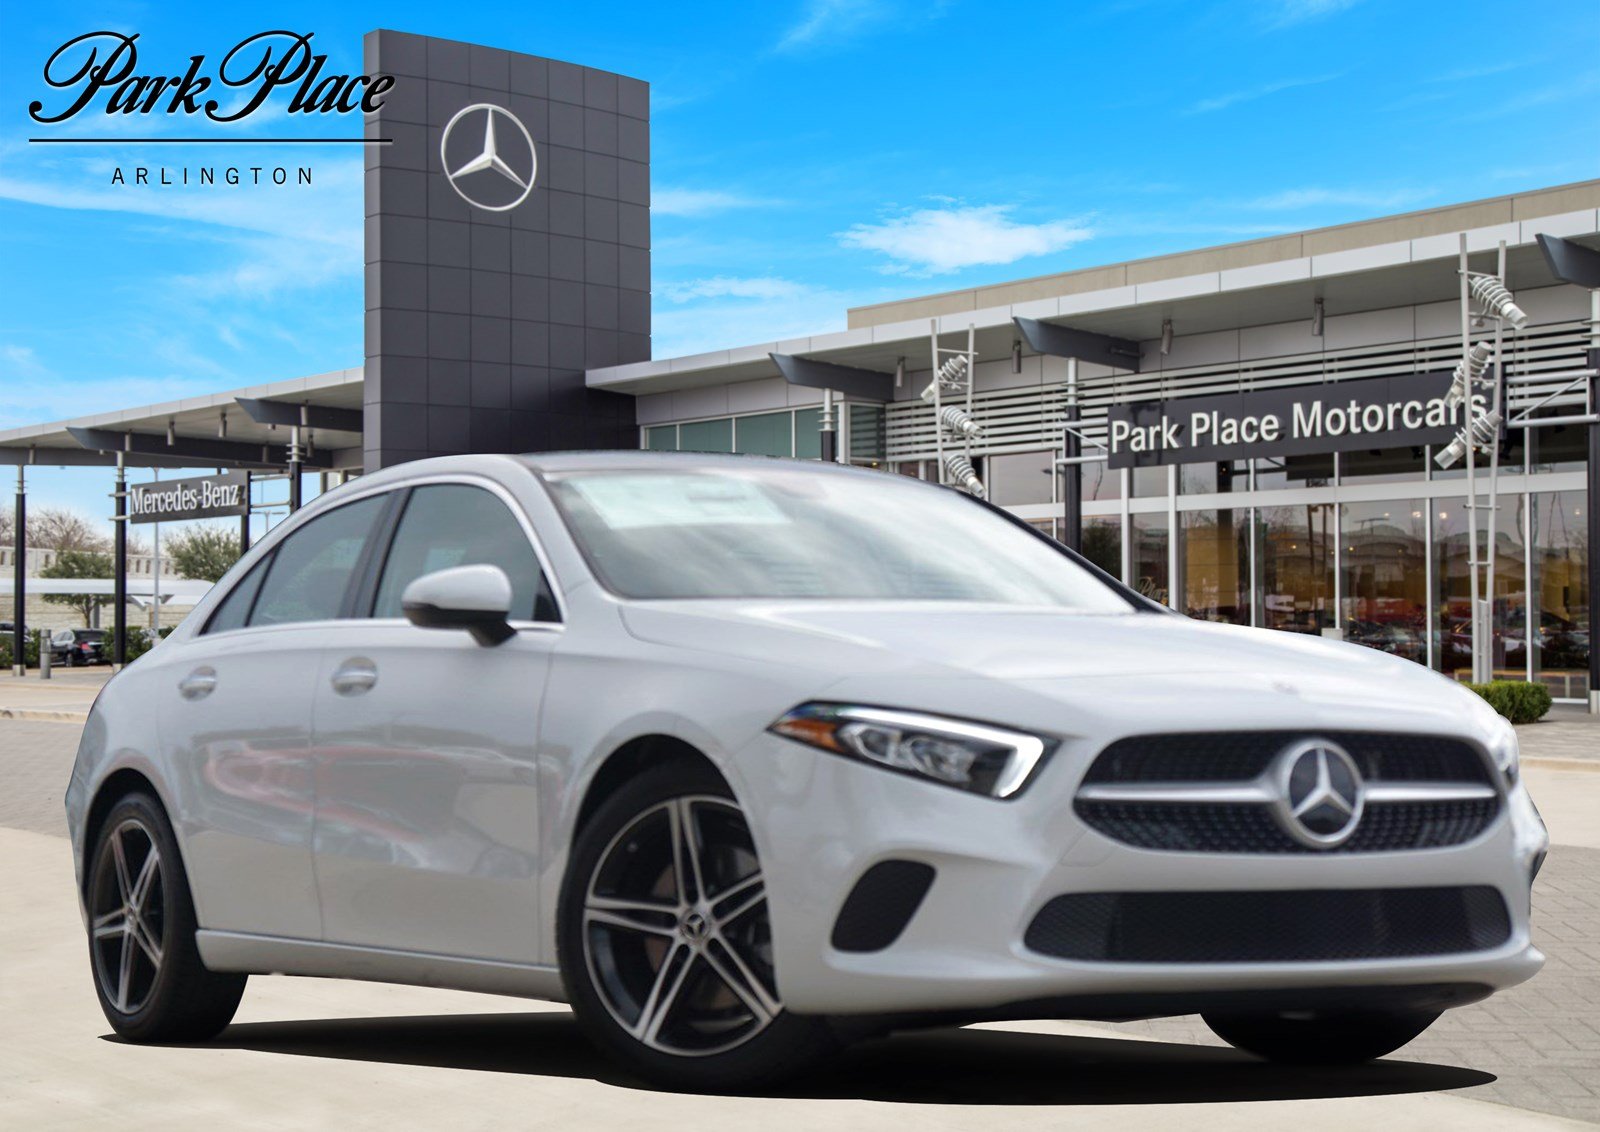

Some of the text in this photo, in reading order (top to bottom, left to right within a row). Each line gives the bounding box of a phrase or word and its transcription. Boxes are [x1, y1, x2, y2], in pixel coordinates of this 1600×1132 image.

[1110, 416, 1180, 454] Park
[1191, 411, 1280, 446] Place
[131, 480, 239, 515] Mercedes-Benz
